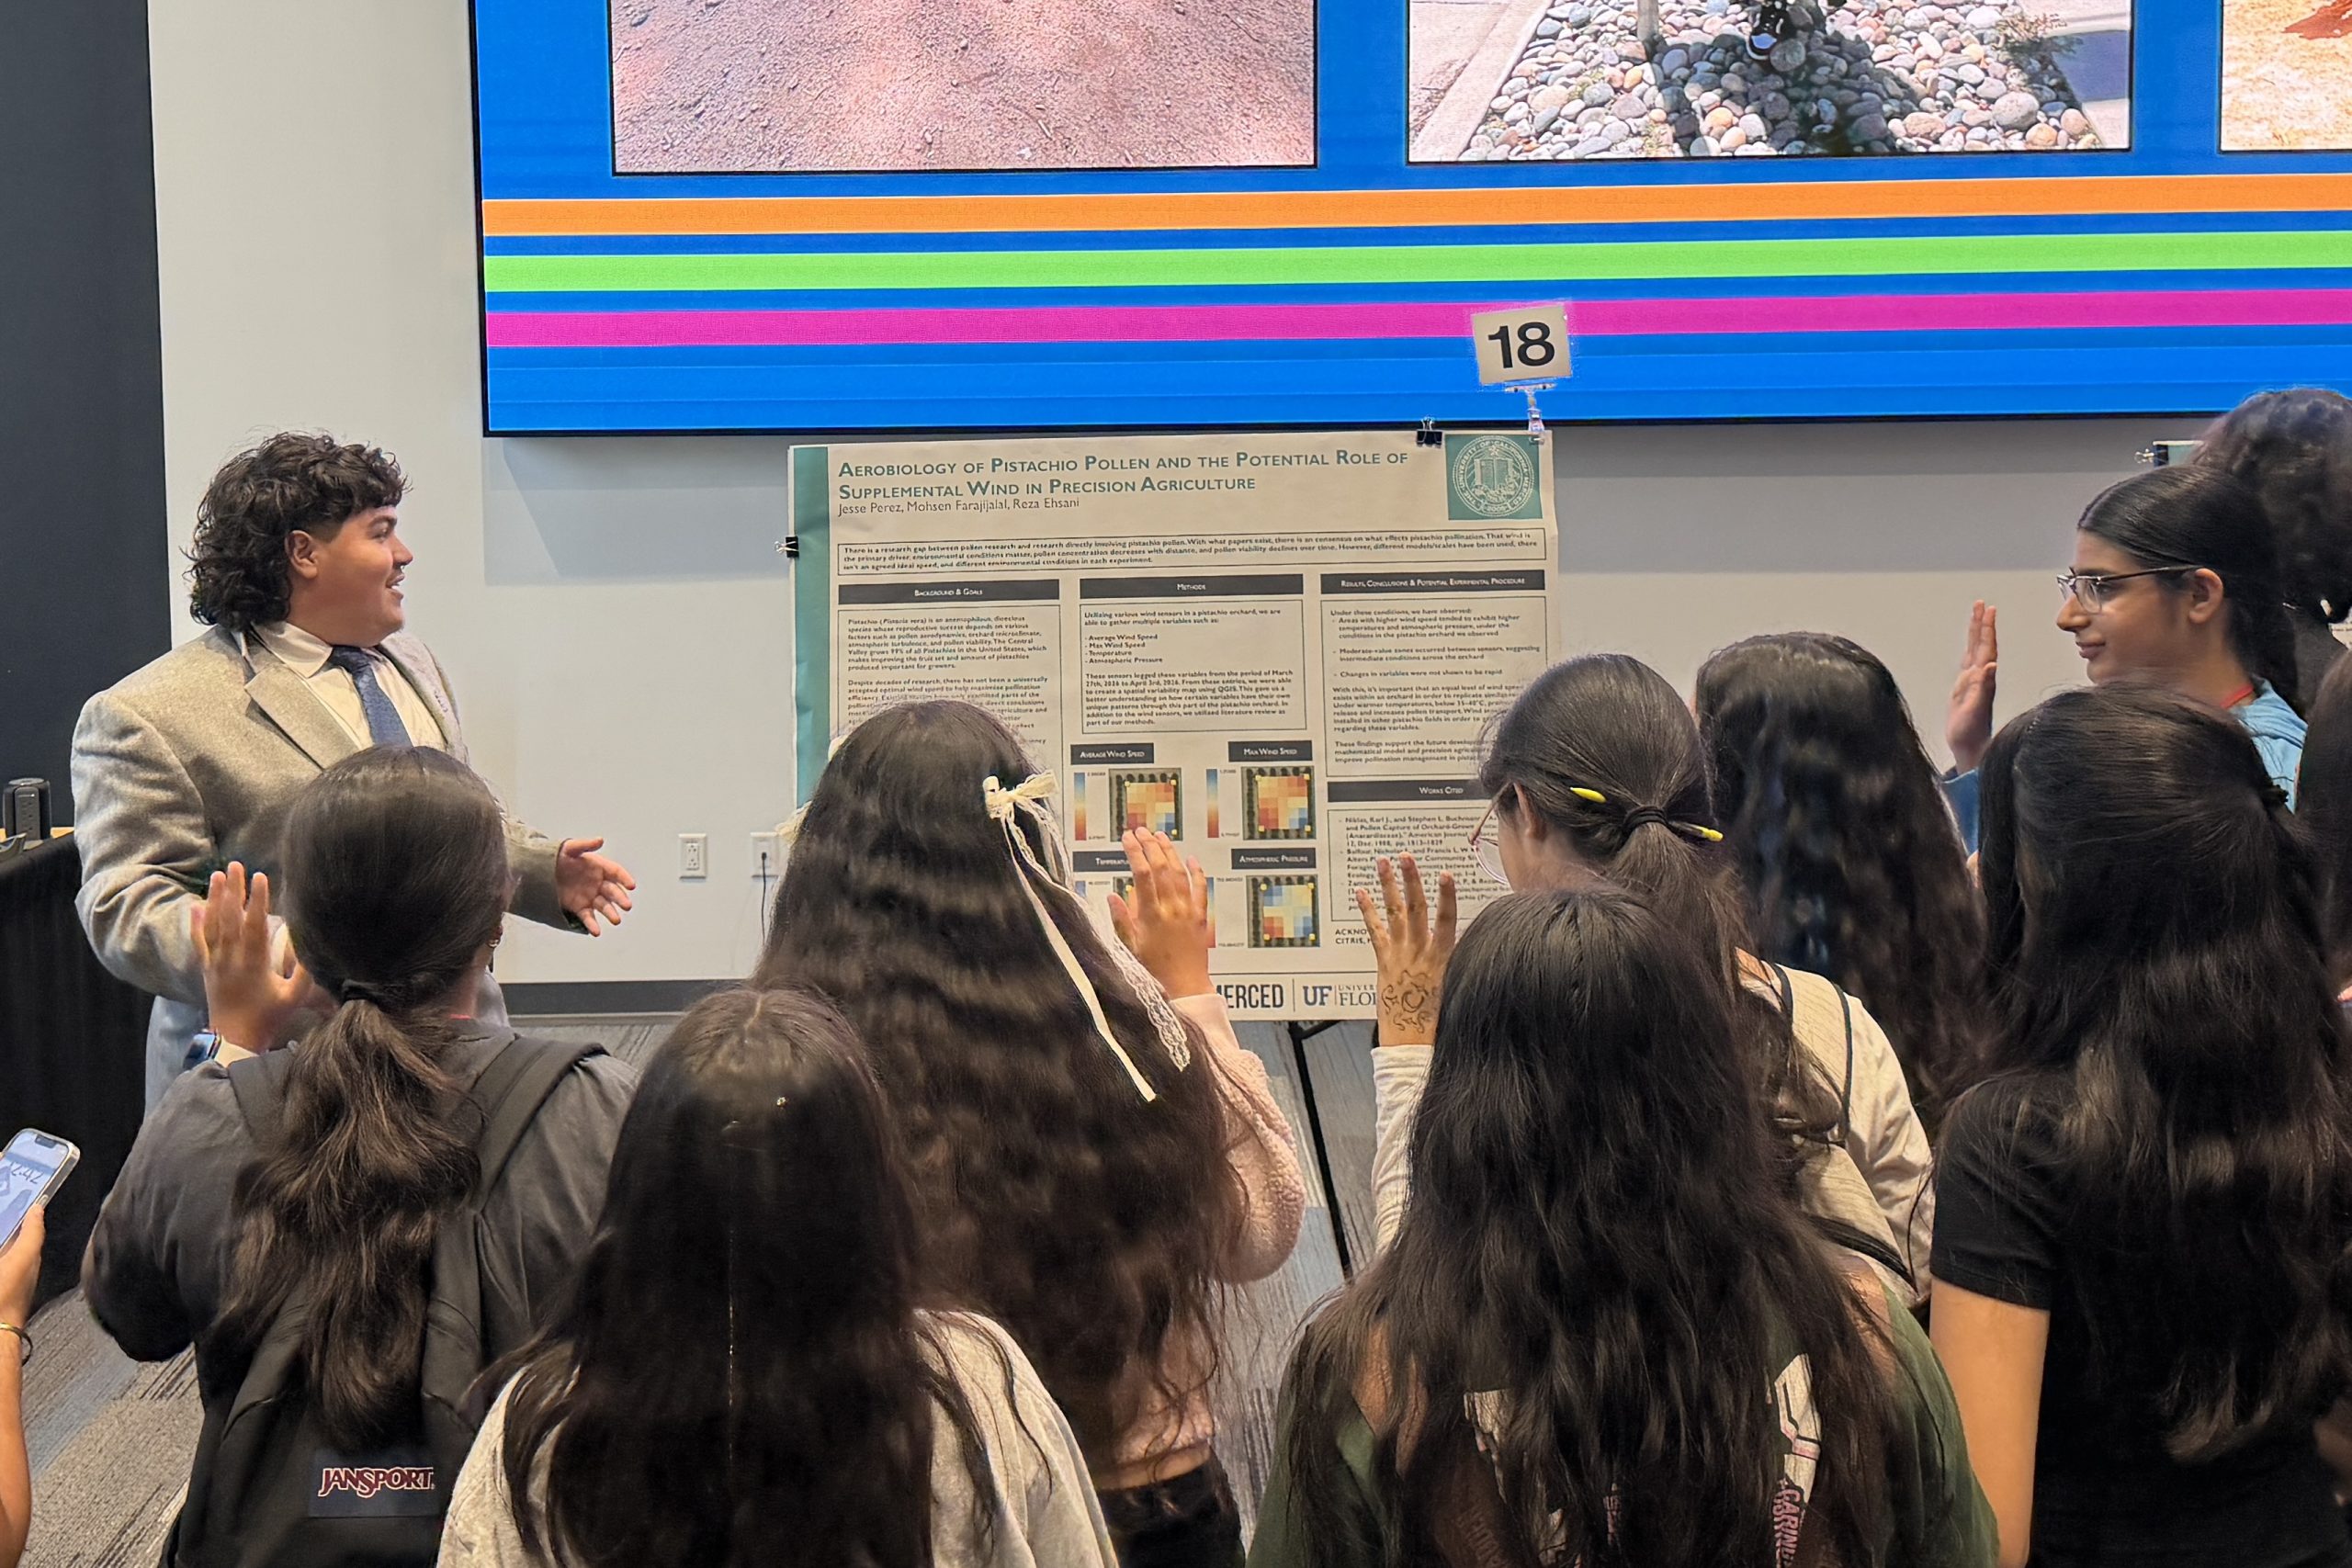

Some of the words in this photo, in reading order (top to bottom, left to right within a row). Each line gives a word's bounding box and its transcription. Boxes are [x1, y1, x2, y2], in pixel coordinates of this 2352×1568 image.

[1488, 322, 1555, 369] 18
[839, 462, 956, 477] AEROBIOLOGY
[963, 462, 984, 474] OF
[992, 458, 1077, 473] PISTACHIO
[1085, 455, 1149, 470] POLLEN
[1157, 457, 1191, 468] AND
[1198, 456, 1229, 468] THE
[1236, 451, 1329, 466] POTENTIAL
[1336, 450, 1380, 464] ROLE
[1386, 453, 1408, 464] OF
[839, 484, 963, 499] SUPPLEMENTAL
[967, 480, 1019, 496] WIND
[1027, 483, 1042, 494] IN
[1050, 479, 1135, 493] PRECISION
[1141, 476, 1256, 492] AGRICULTURE
[838, 502, 866, 517] Jesse
[870, 502, 904, 514] Perez,
[907, 500, 951, 512] Mohsen
[1014, 499, 1040, 509] Reza
[1044, 497, 1079, 509] Ehsani
[1089, 634, 1116, 642] Average
[1137, 633, 1158, 641] Speed
[1090, 649, 1132, 658] Temperature
[1090, 657, 1133, 665] Atmospheric
[1134, 672, 1157, 680] logged
[1240, 669, 1263, 678] period
[1303, 985, 1332, 1006] UF
[317, 1466, 435, 1498] JANSPORT
